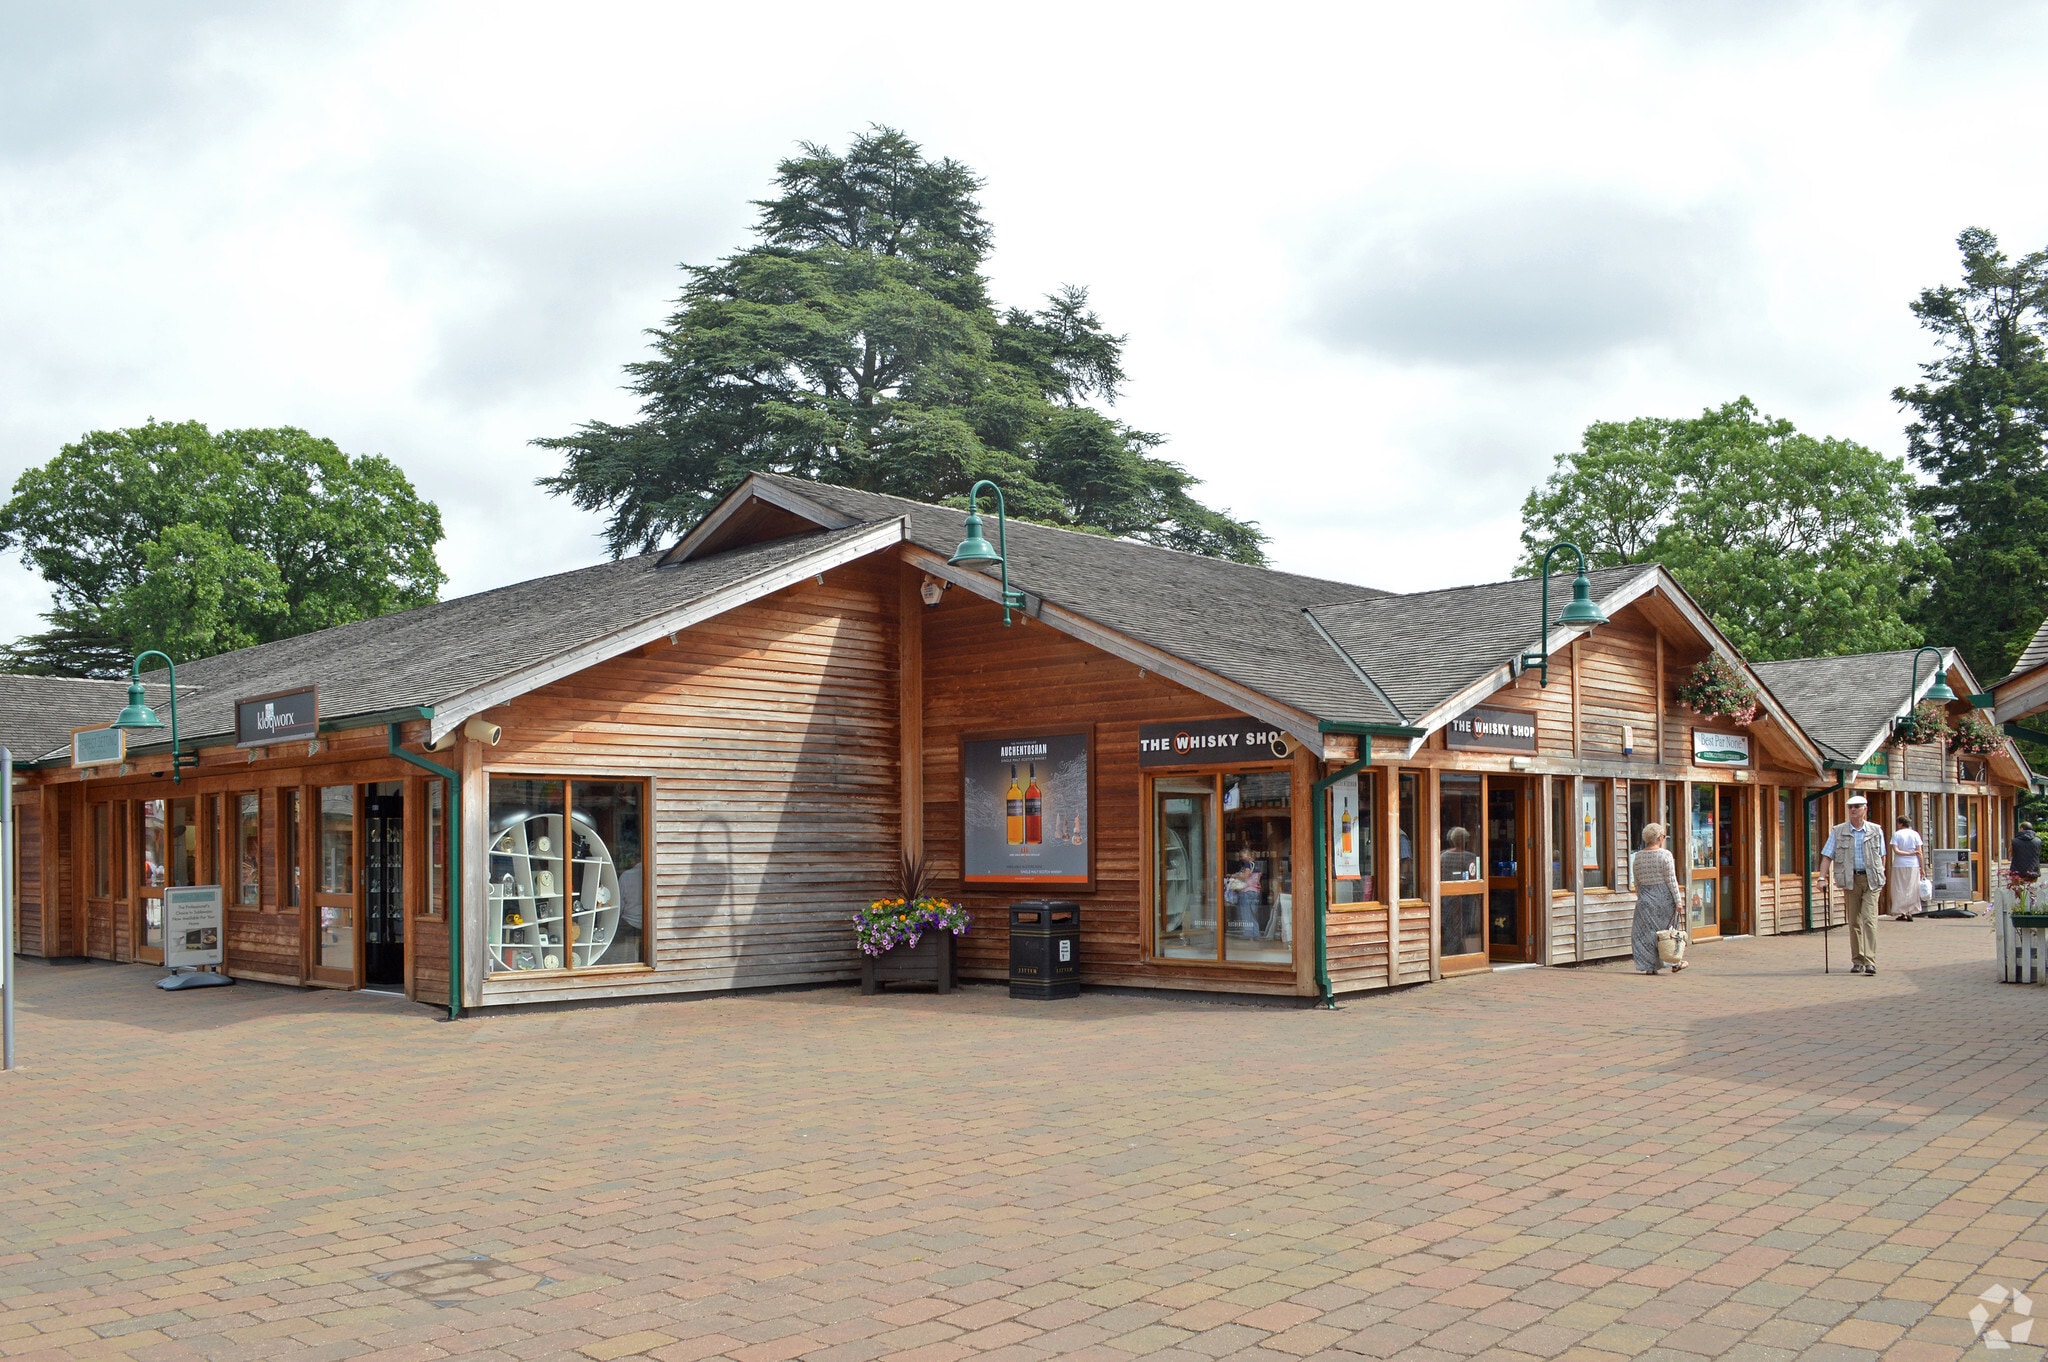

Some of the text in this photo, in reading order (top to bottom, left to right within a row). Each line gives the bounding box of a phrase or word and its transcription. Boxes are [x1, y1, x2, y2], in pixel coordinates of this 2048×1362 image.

[1453, 720, 1535, 738] THE WHISKY SHOP
[1141, 731, 1286, 751] THE WHISKY SHO
[1701, 733, 1742, 750] Best Par None
[1001, 744, 1047, 756] AUCHENTOSHAN
